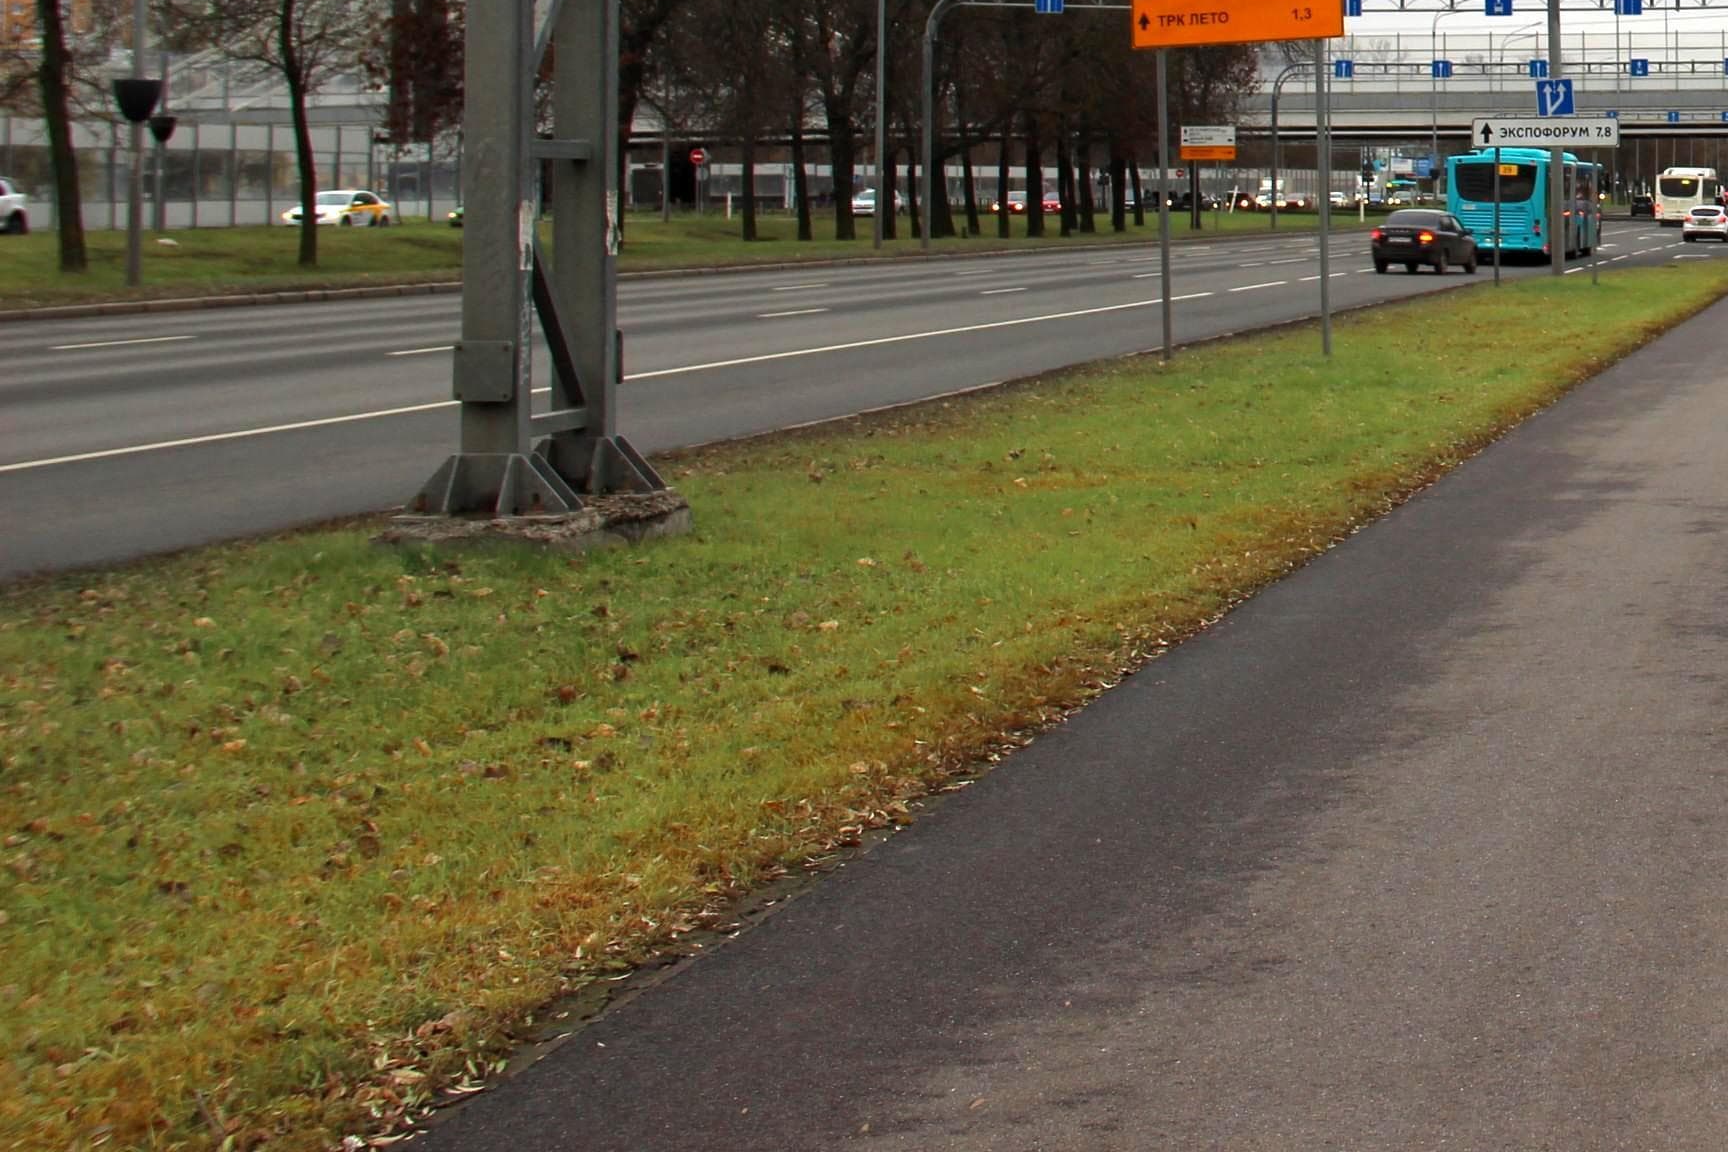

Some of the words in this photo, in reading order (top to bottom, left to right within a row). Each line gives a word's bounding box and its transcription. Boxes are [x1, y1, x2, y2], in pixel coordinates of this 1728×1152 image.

[1158, 14, 1185, 27] ТРК
[1190, 11, 1230, 26] ЛЕТО
[1500, 126, 1590, 139] ЭКСПОФОРУМ
